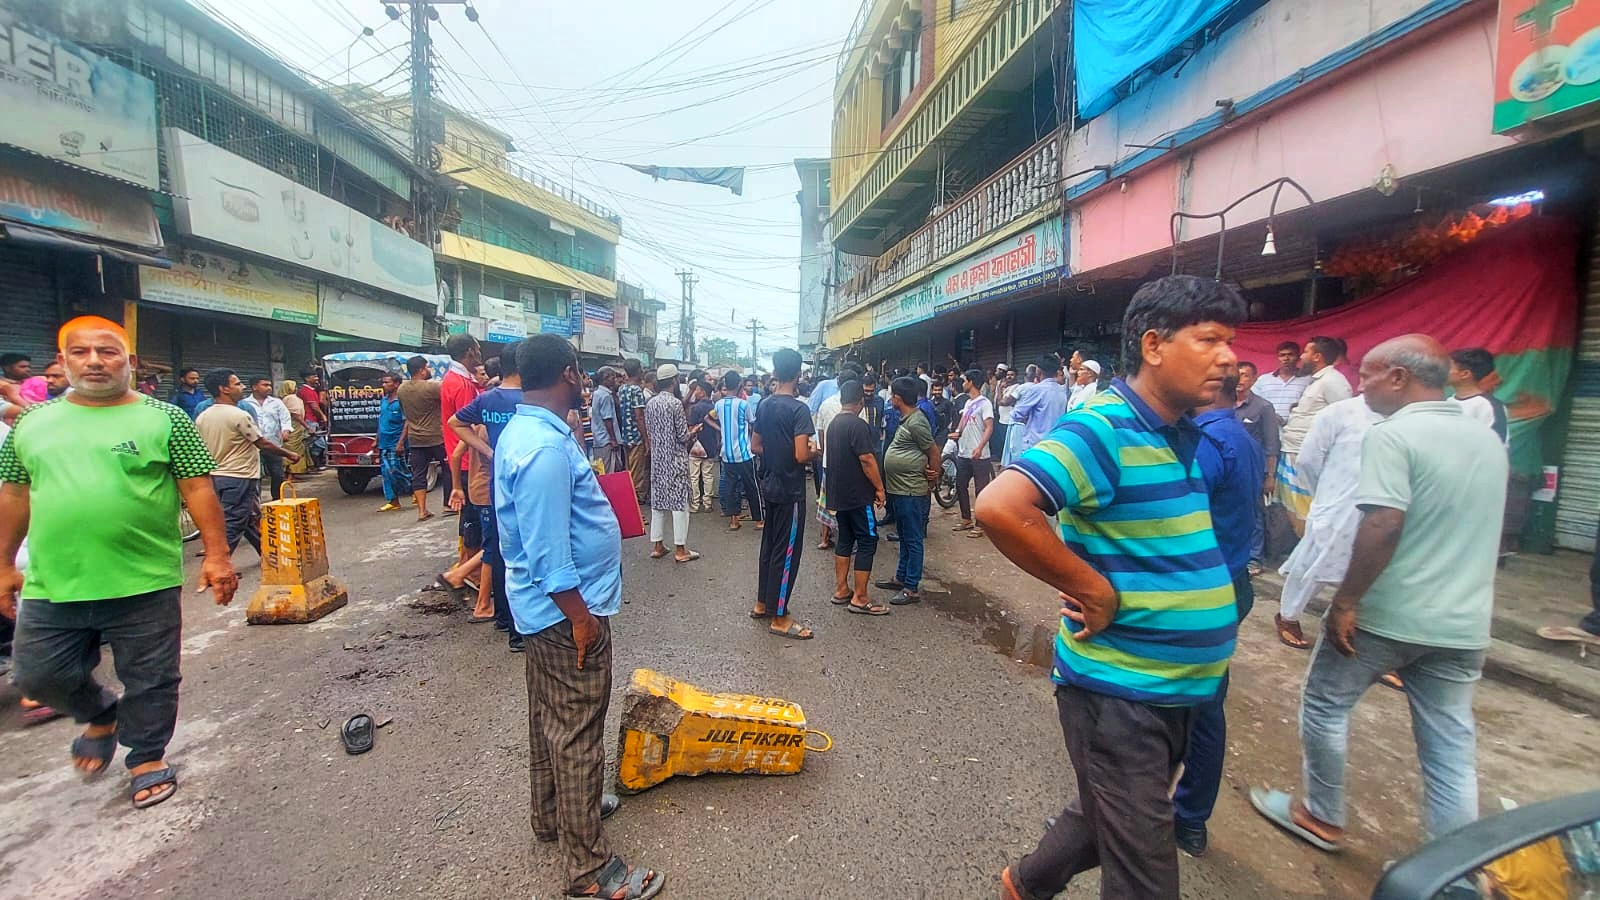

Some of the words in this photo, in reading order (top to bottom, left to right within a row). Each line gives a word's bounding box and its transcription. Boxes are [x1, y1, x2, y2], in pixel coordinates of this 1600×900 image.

[266, 505, 279, 574] JULFIKAR
[279, 511, 292, 567] STEEL
[712, 699, 796, 718] STEEL
[698, 729, 804, 748] JULFIKAR
[704, 747, 791, 766] STEEL
